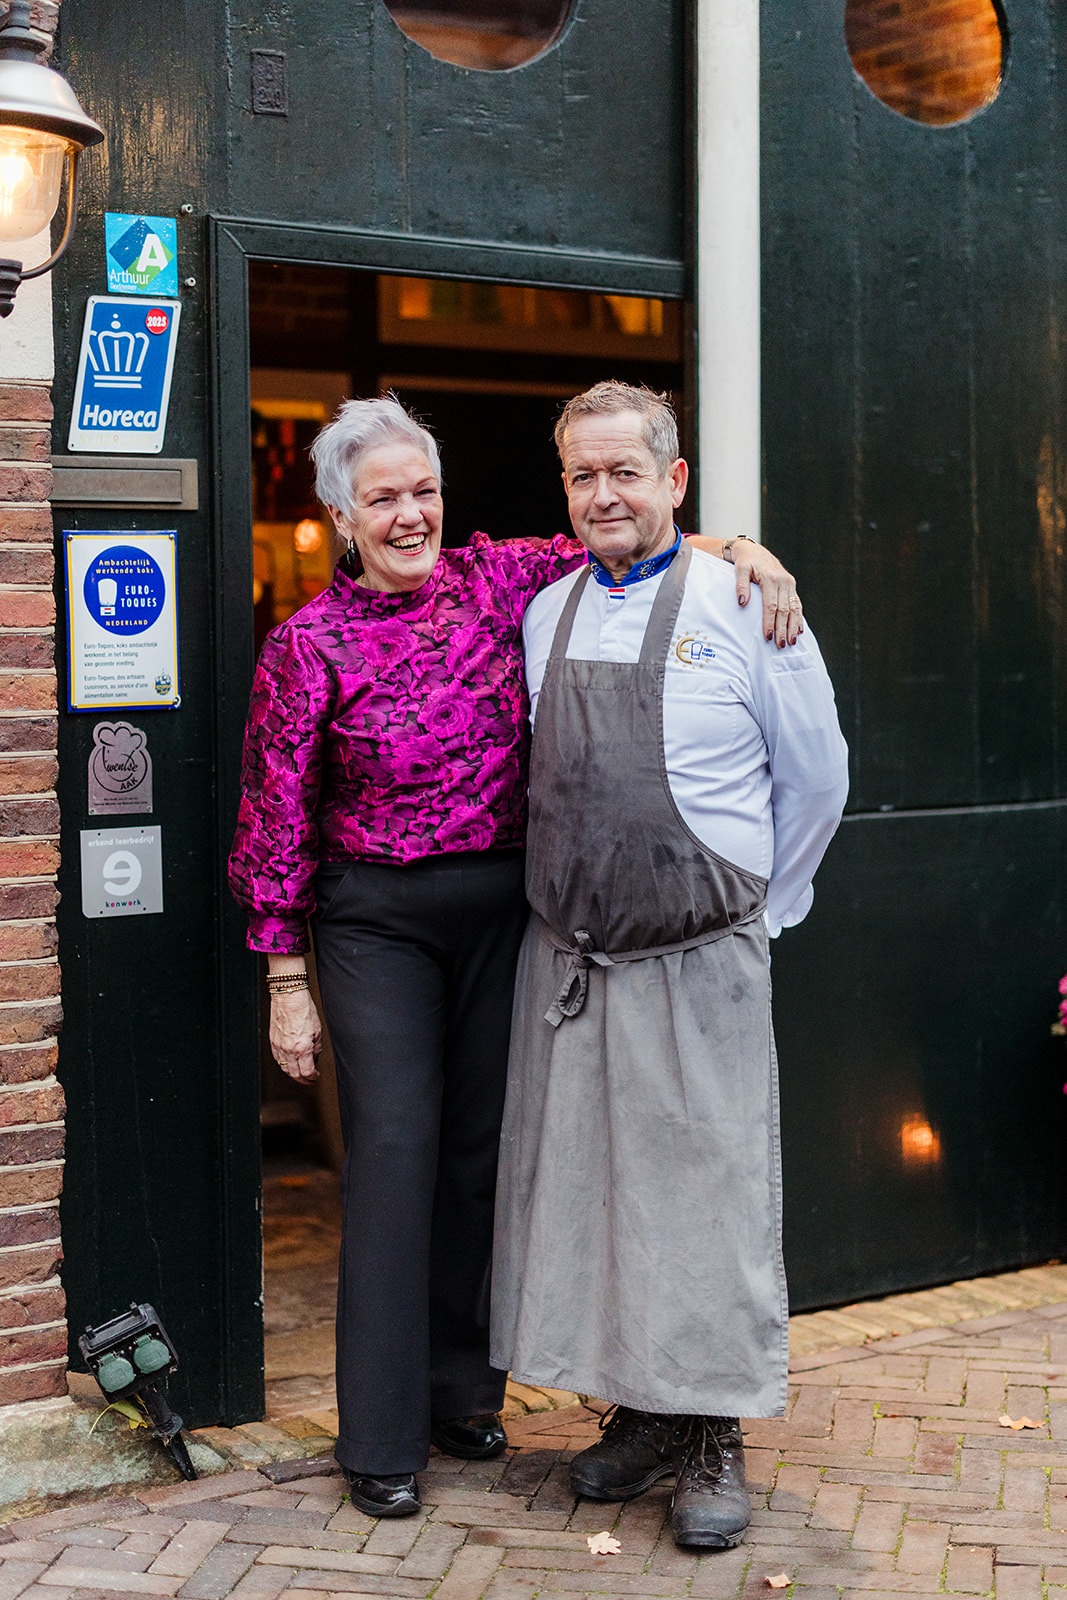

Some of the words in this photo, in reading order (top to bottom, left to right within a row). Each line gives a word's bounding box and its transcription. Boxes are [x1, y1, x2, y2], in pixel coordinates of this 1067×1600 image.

[109, 268, 150, 285] Arthuur
[147, 315, 166, 327] 2025
[82, 404, 157, 428] Horeca
[98, 559, 150, 567] Ambachtelijk
[136, 566, 154, 574] koks
[125, 585, 154, 595] EURO-
[120, 597, 157, 608] TOQUES
[105, 619, 148, 627] NEDERLAND
[120, 777, 138, 791] AAK
[88, 838, 114, 847] erkend
[115, 835, 154, 846] leerbedrijf
[105, 898, 142, 908] kenwerk
